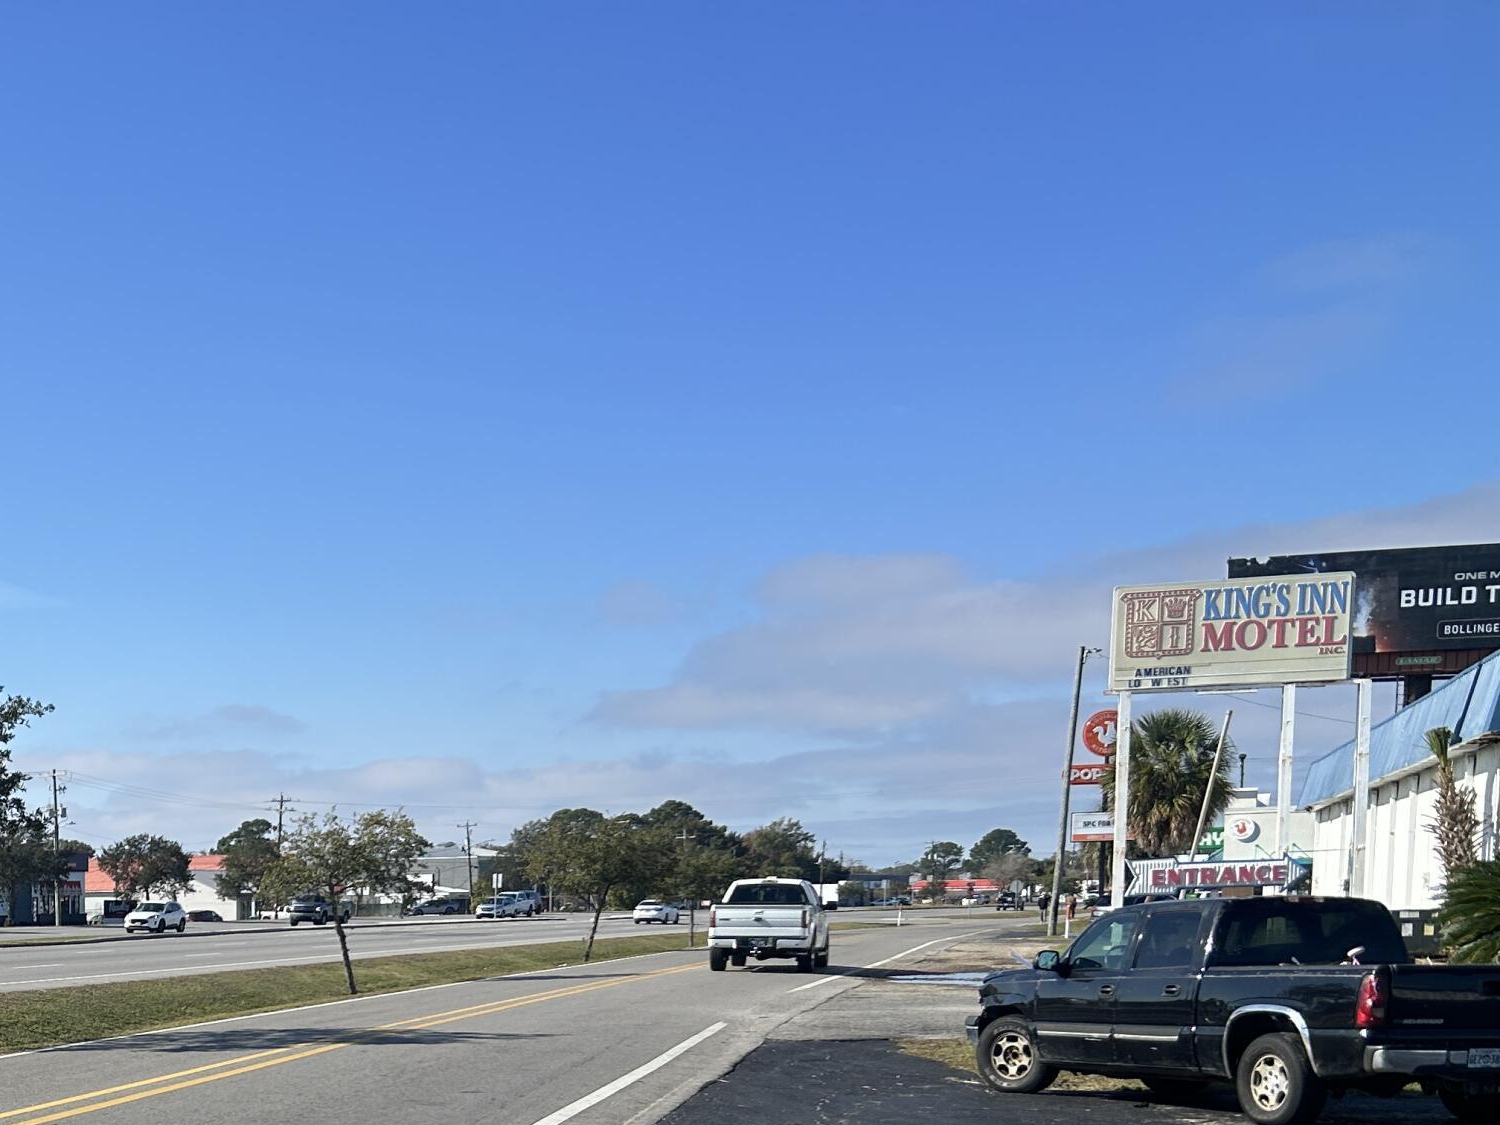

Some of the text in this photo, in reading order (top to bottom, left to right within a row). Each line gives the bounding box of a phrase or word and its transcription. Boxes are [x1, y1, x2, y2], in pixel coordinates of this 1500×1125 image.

[1454, 571, 1487, 580] ONE
[1202, 581, 1349, 621] KING'S INN
[1400, 585, 1500, 608] BUILD T
[1200, 616, 1347, 652] MOTEL
[1444, 623, 1500, 635] BOLLINGE
[1319, 646, 1346, 655] INC.
[1135, 666, 1192, 678] AMERICAN
[1151, 865, 1288, 887] ENTRANCE
